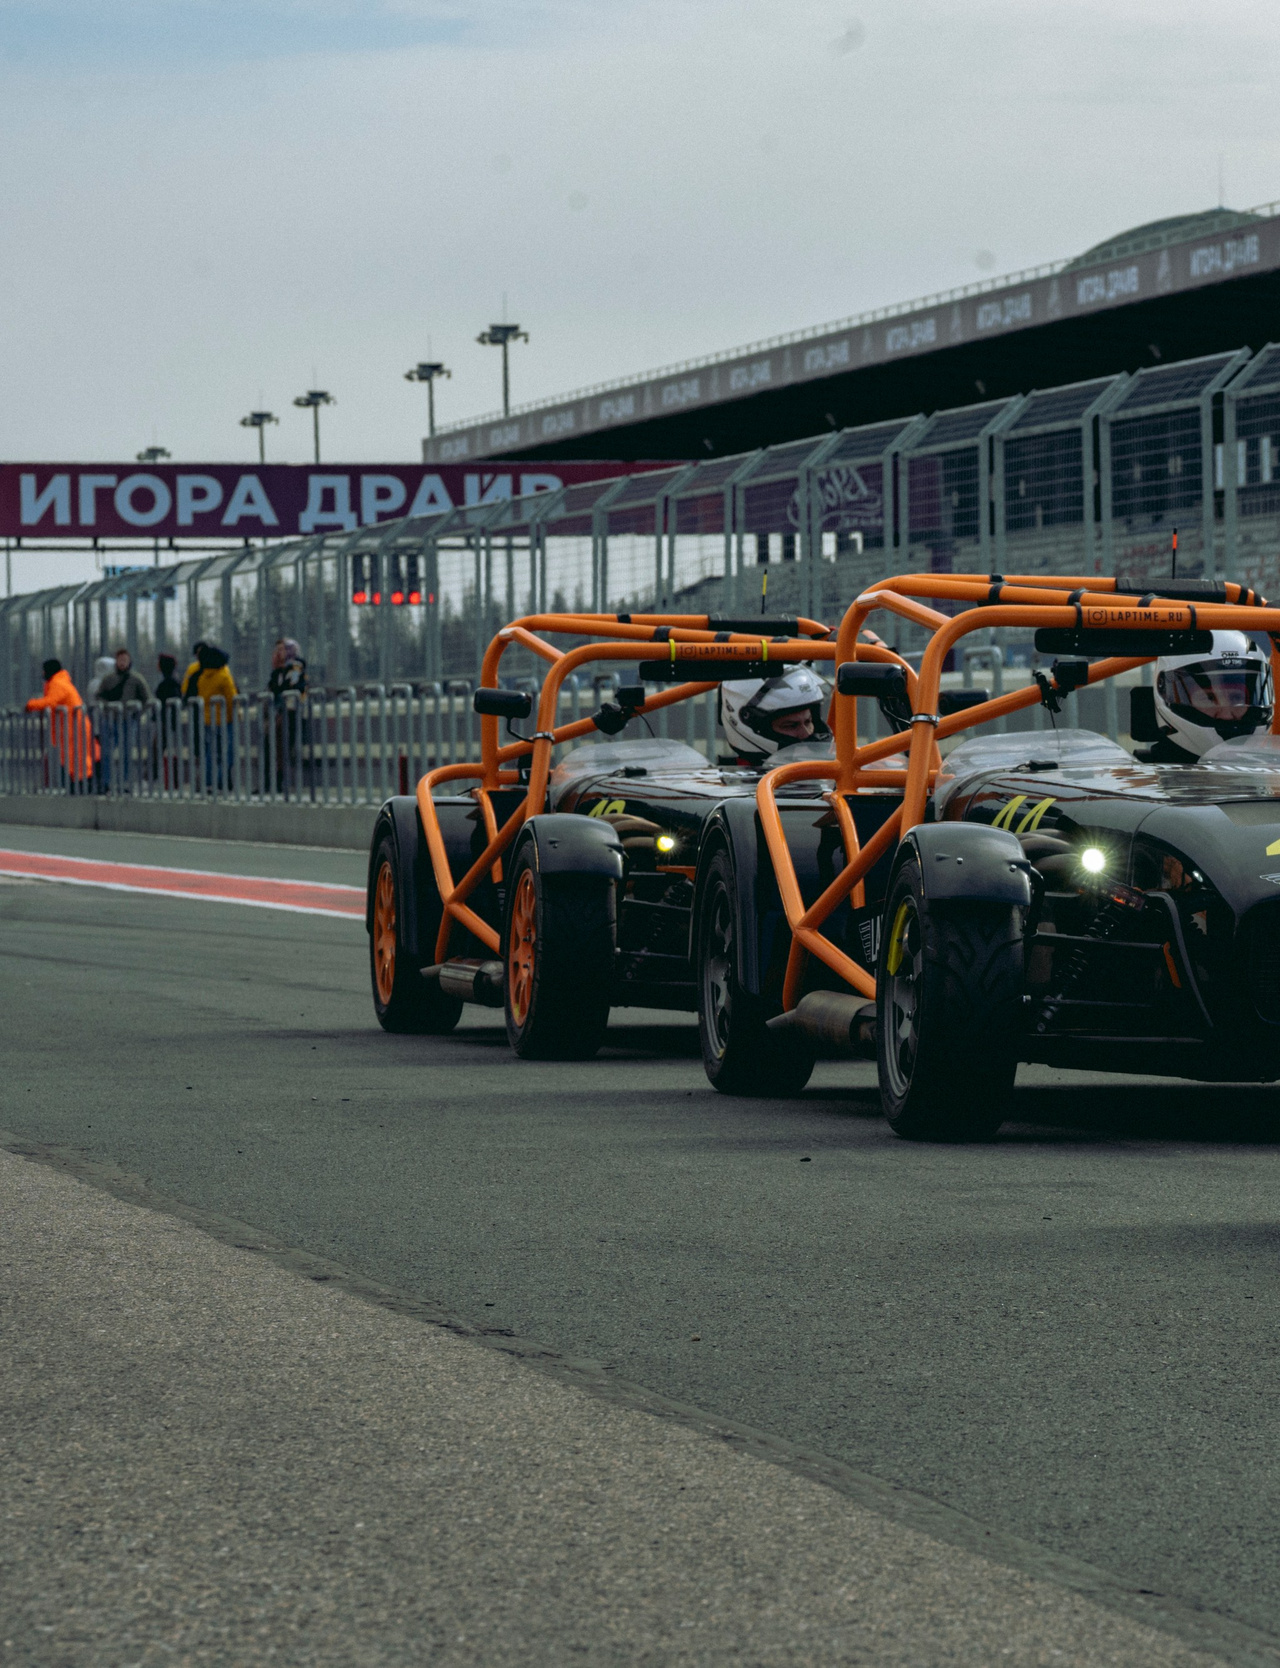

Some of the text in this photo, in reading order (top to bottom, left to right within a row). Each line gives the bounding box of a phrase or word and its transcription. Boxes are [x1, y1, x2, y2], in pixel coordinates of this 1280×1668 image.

[19, 473, 280, 527] ИГОРА
[1110, 611, 1183, 622] LAPTIME_RU
[699, 646, 758, 656] LAPTIME_RU
